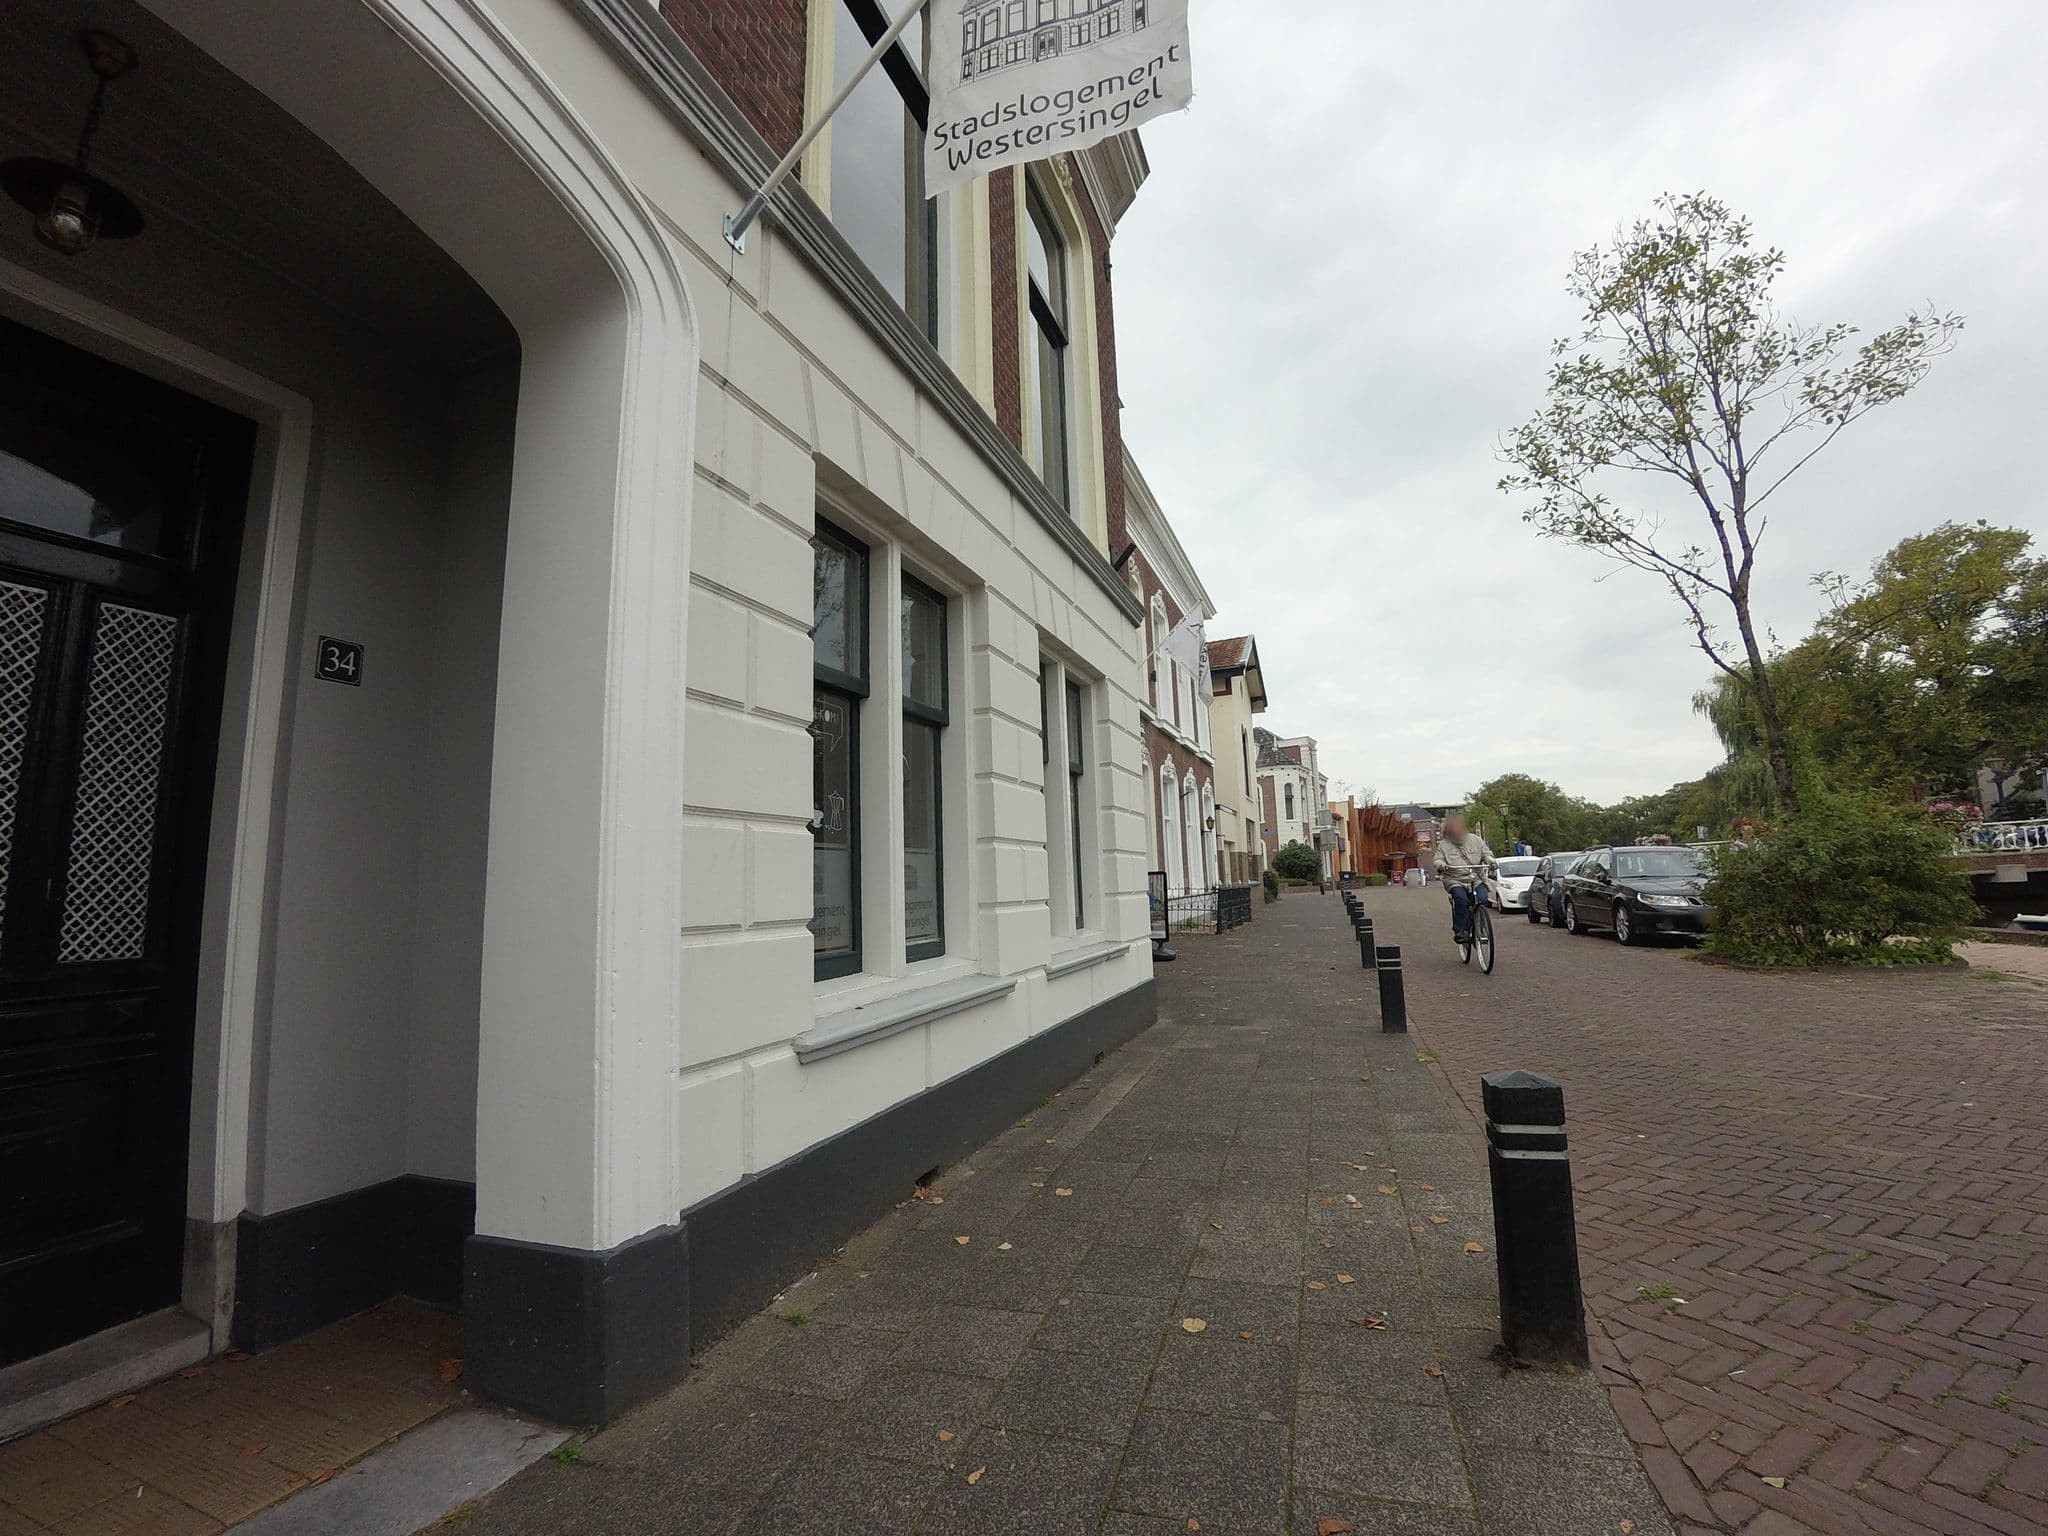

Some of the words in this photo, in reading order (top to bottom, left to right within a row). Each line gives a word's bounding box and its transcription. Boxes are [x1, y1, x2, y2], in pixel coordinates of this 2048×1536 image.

[933, 44, 1179, 151] Stadslogement
[947, 76, 1163, 171] Westersingel
[324, 646, 356, 676] 34
